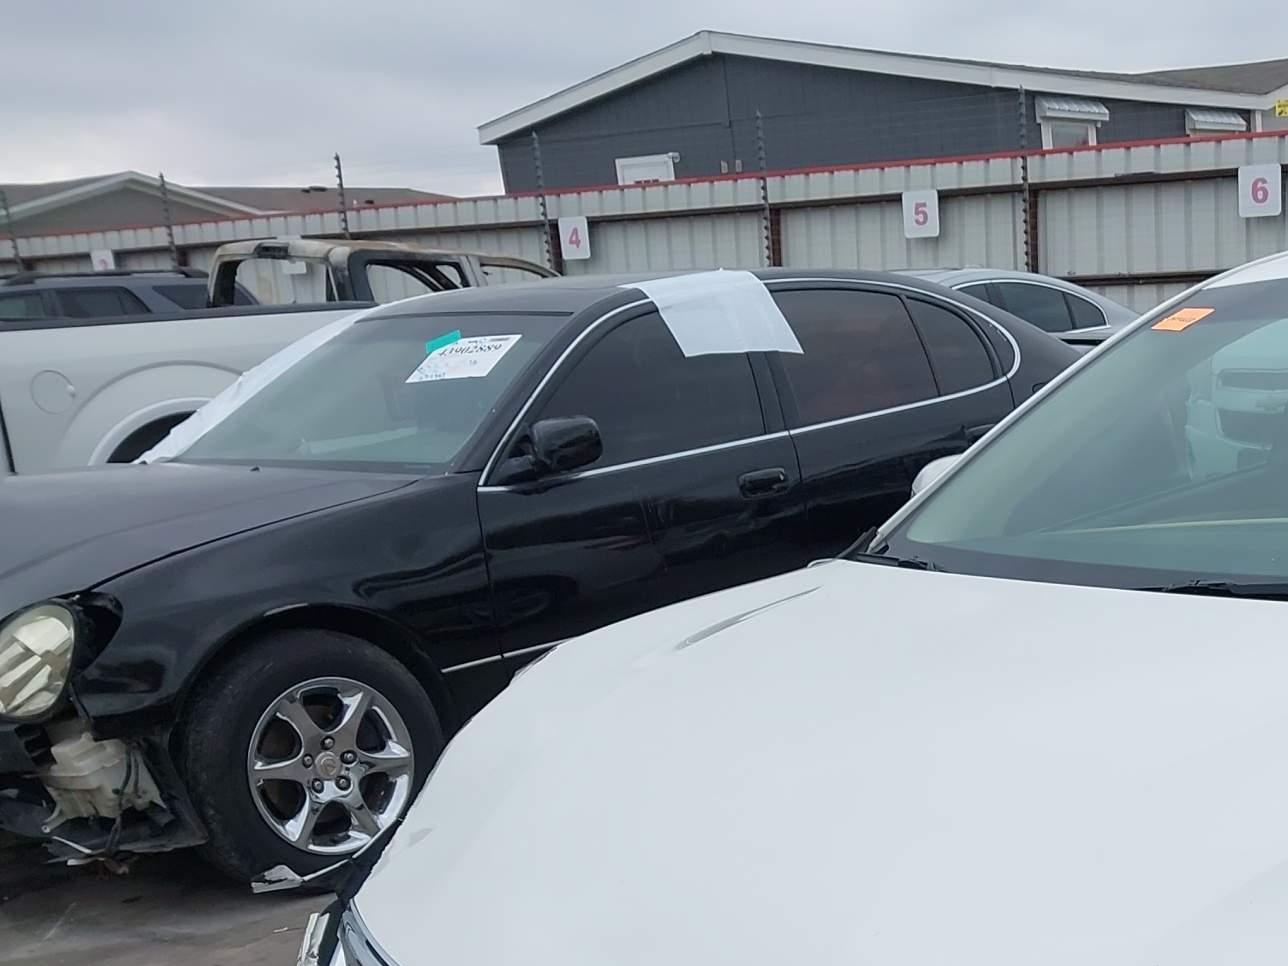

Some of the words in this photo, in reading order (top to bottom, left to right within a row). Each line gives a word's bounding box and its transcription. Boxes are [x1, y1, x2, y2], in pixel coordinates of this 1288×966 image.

[1251, 177, 1269, 203] 6
[914, 202, 928, 225] 5
[569, 227, 581, 248] 4
